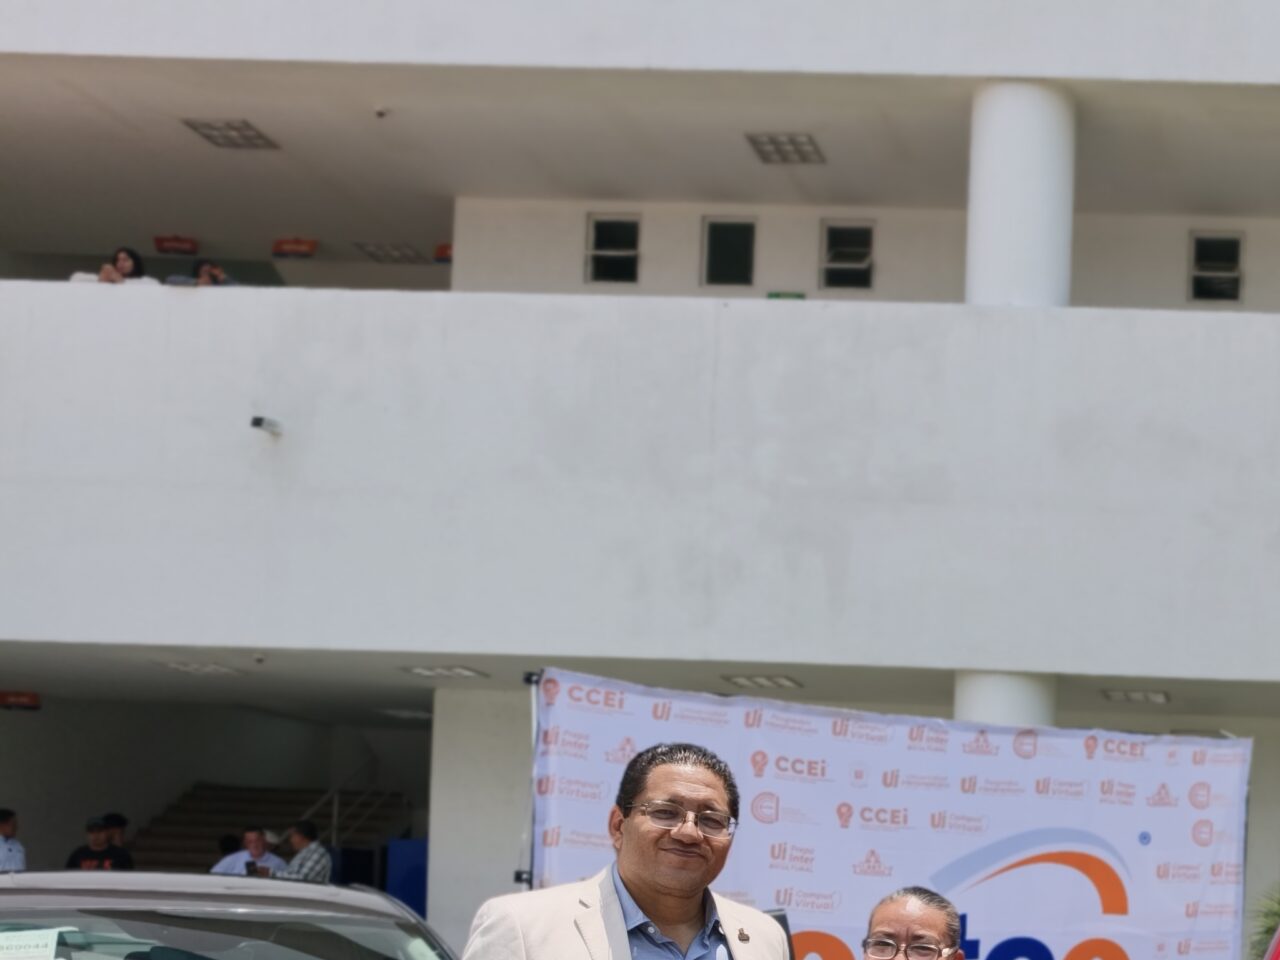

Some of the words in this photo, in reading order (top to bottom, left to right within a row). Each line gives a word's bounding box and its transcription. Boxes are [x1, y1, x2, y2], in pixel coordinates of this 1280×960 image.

[567, 685, 625, 709] CCEi
[1103, 739, 1147, 756] CCEi
[774, 756, 827, 778] CCEi
[859, 807, 909, 826] CCEi
[788, 853, 815, 865] Inter
[795, 899, 834, 910] Virtual
